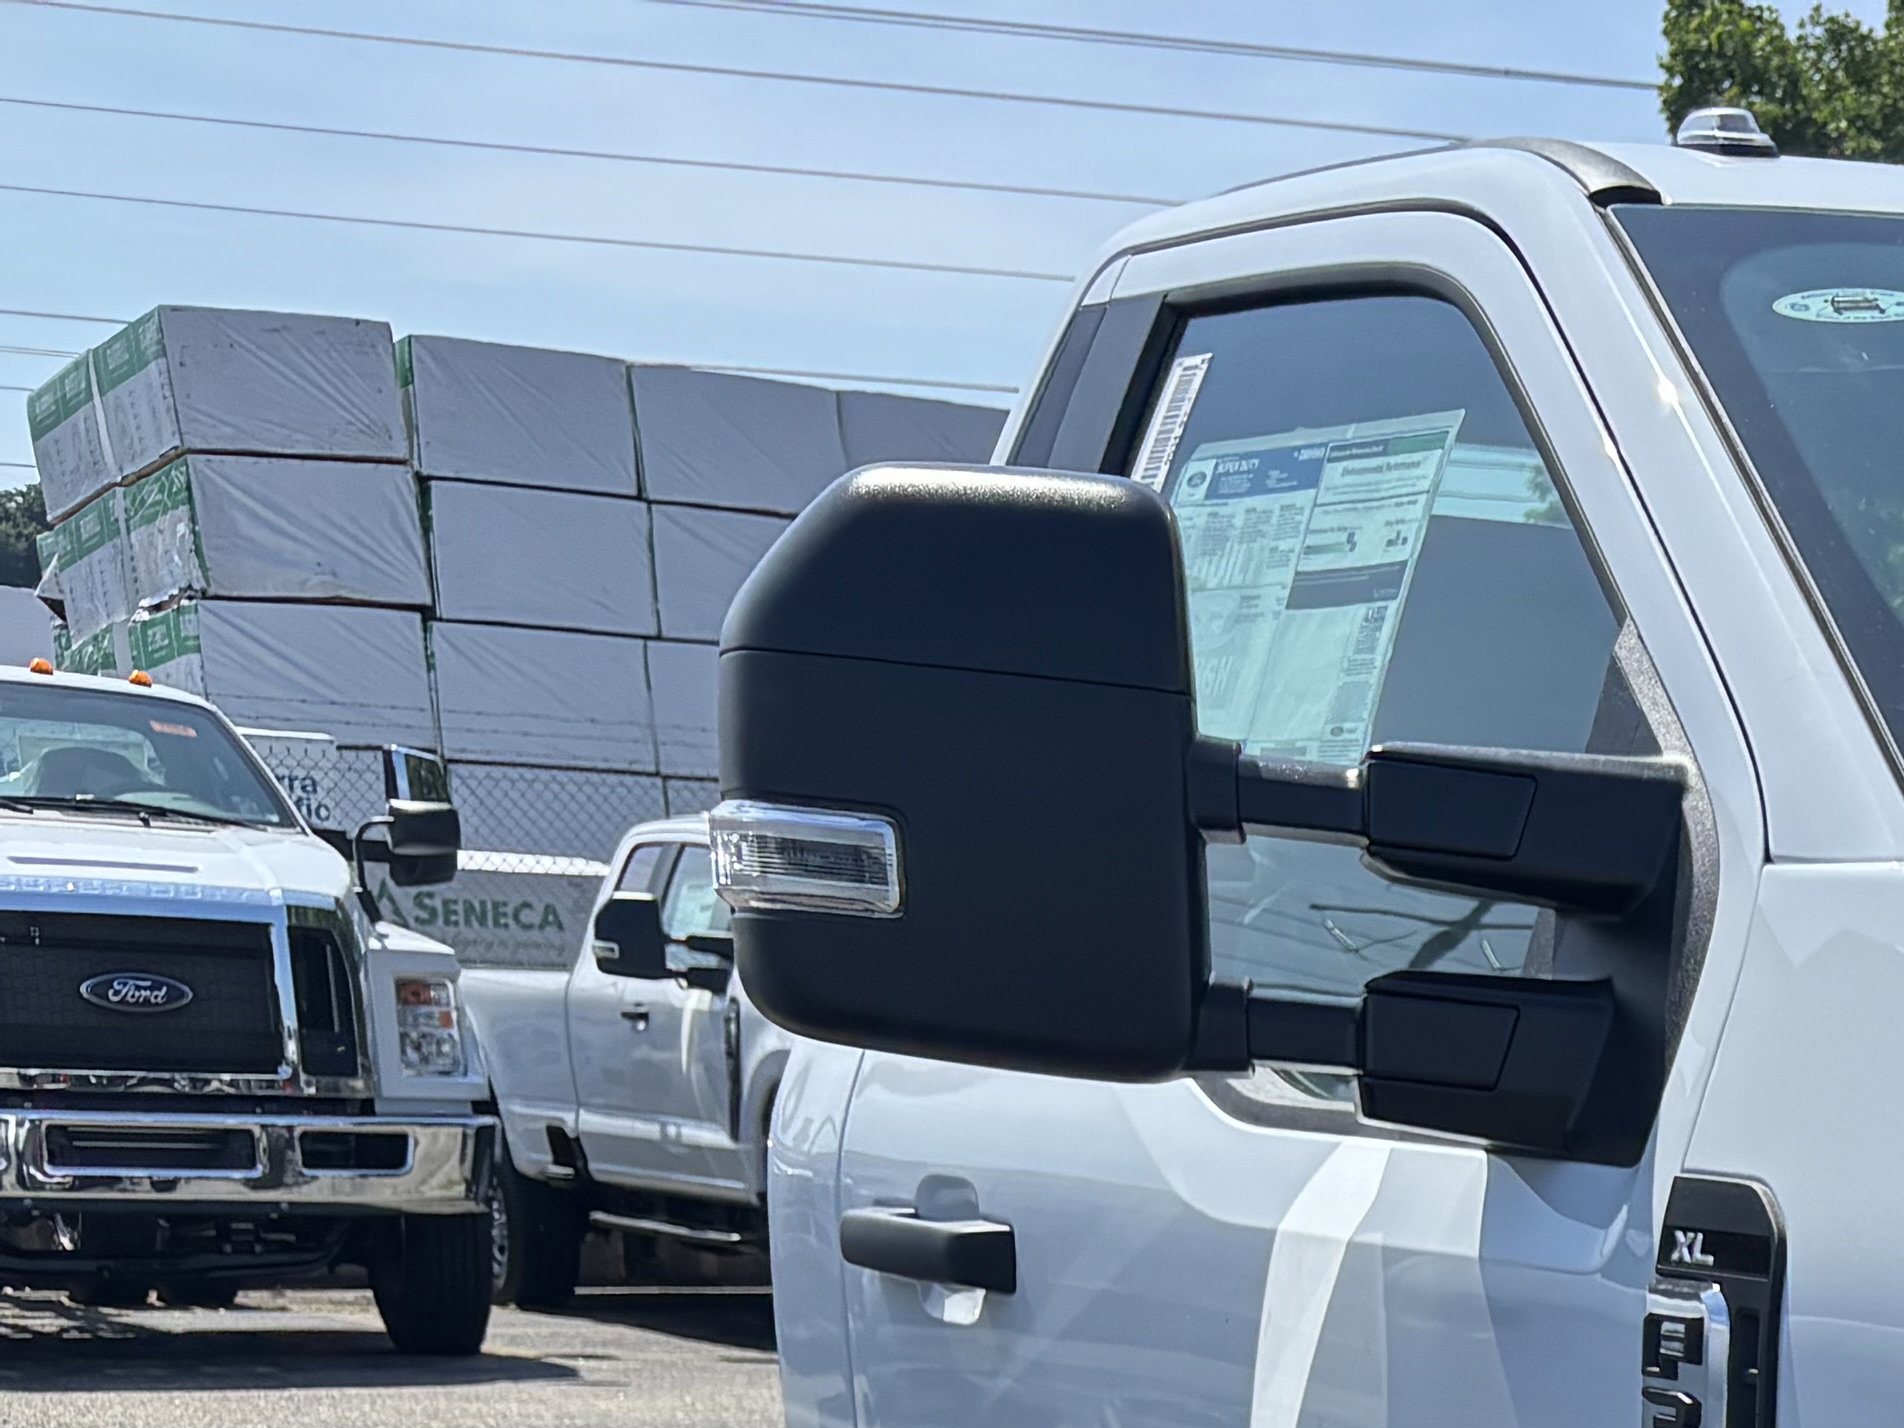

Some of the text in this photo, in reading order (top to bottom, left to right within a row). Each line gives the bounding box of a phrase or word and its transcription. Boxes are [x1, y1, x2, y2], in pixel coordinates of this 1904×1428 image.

[412, 890, 566, 932] SENECA
[108, 978, 167, 1004] Ford
[1671, 1230, 1714, 1266] XL
